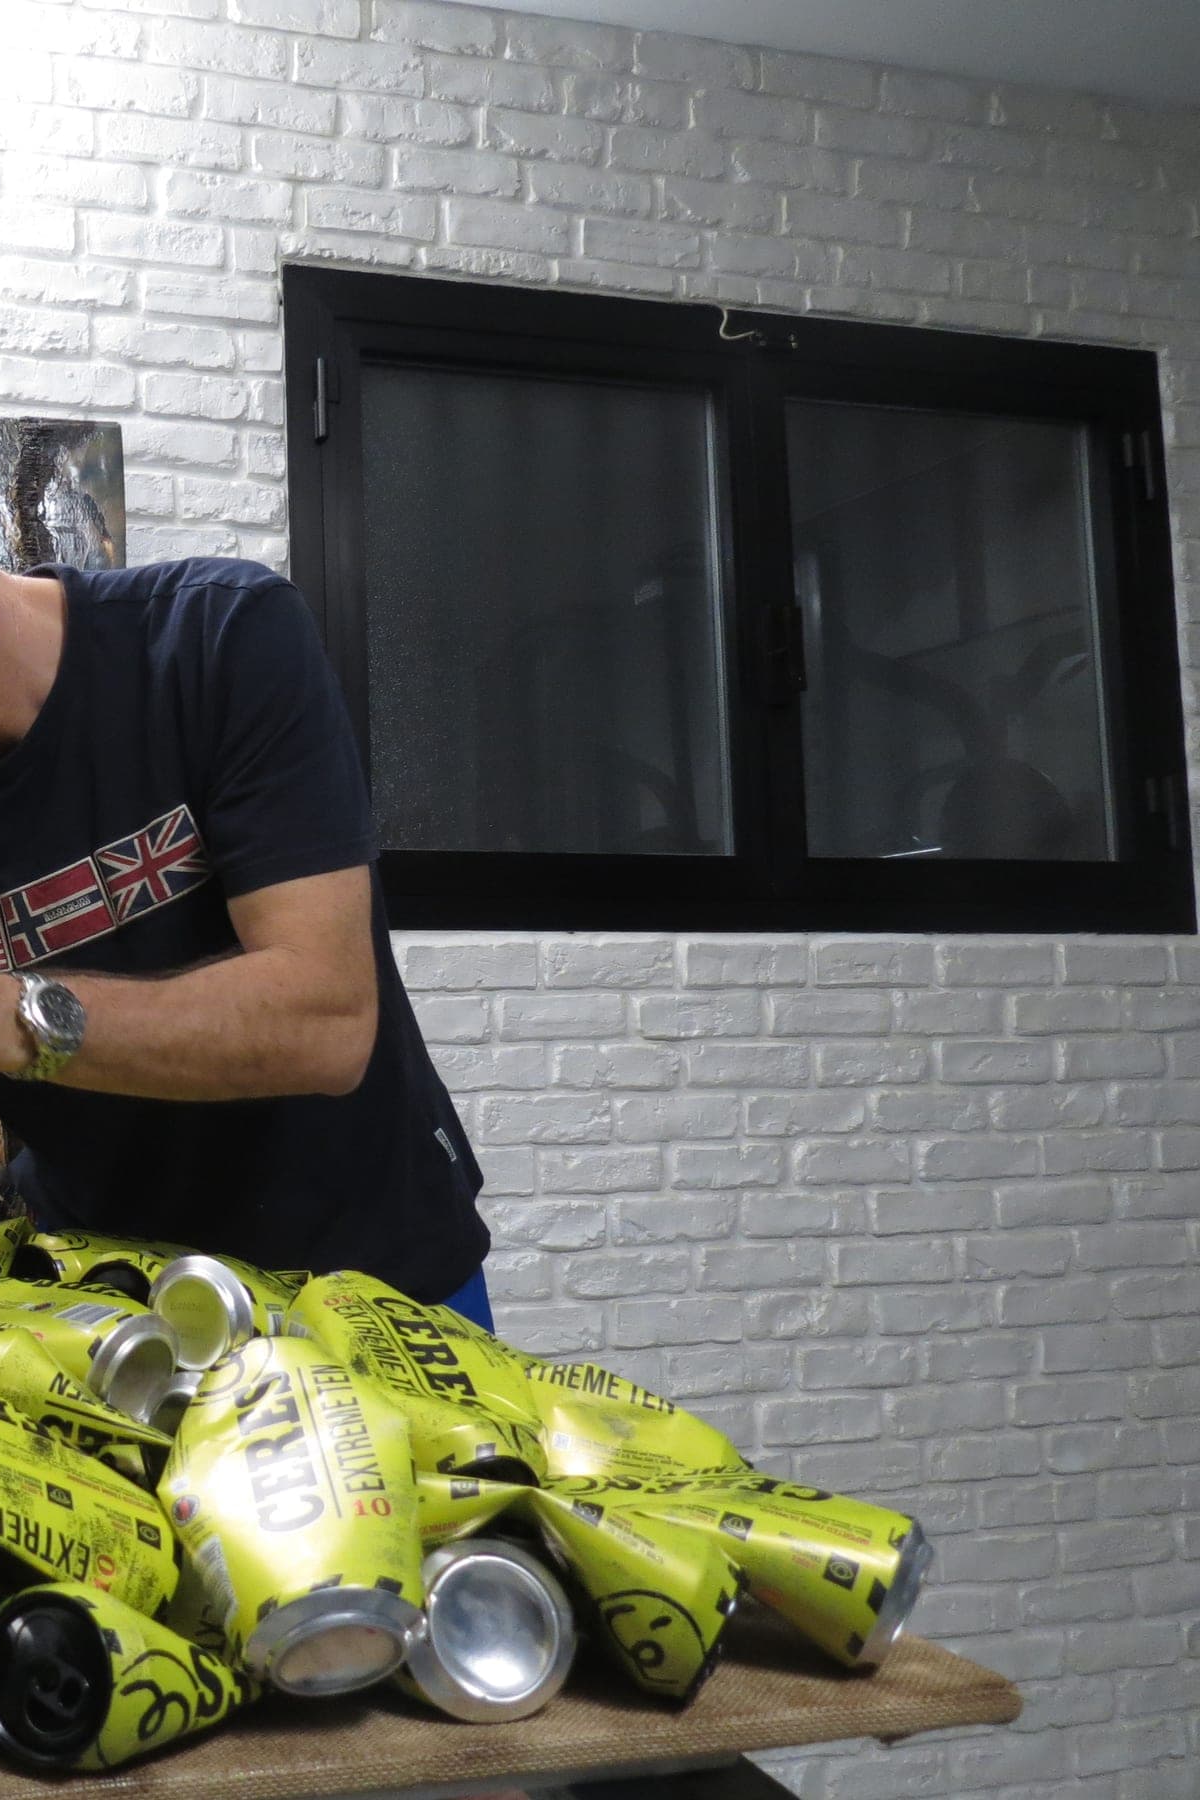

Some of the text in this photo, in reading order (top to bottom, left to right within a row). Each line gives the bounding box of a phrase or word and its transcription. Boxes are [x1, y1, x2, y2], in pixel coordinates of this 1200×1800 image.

[235, 1369, 326, 1532] CERES
[310, 1363, 387, 1494] EXTREME TEN
[352, 1496, 392, 1517] 10
